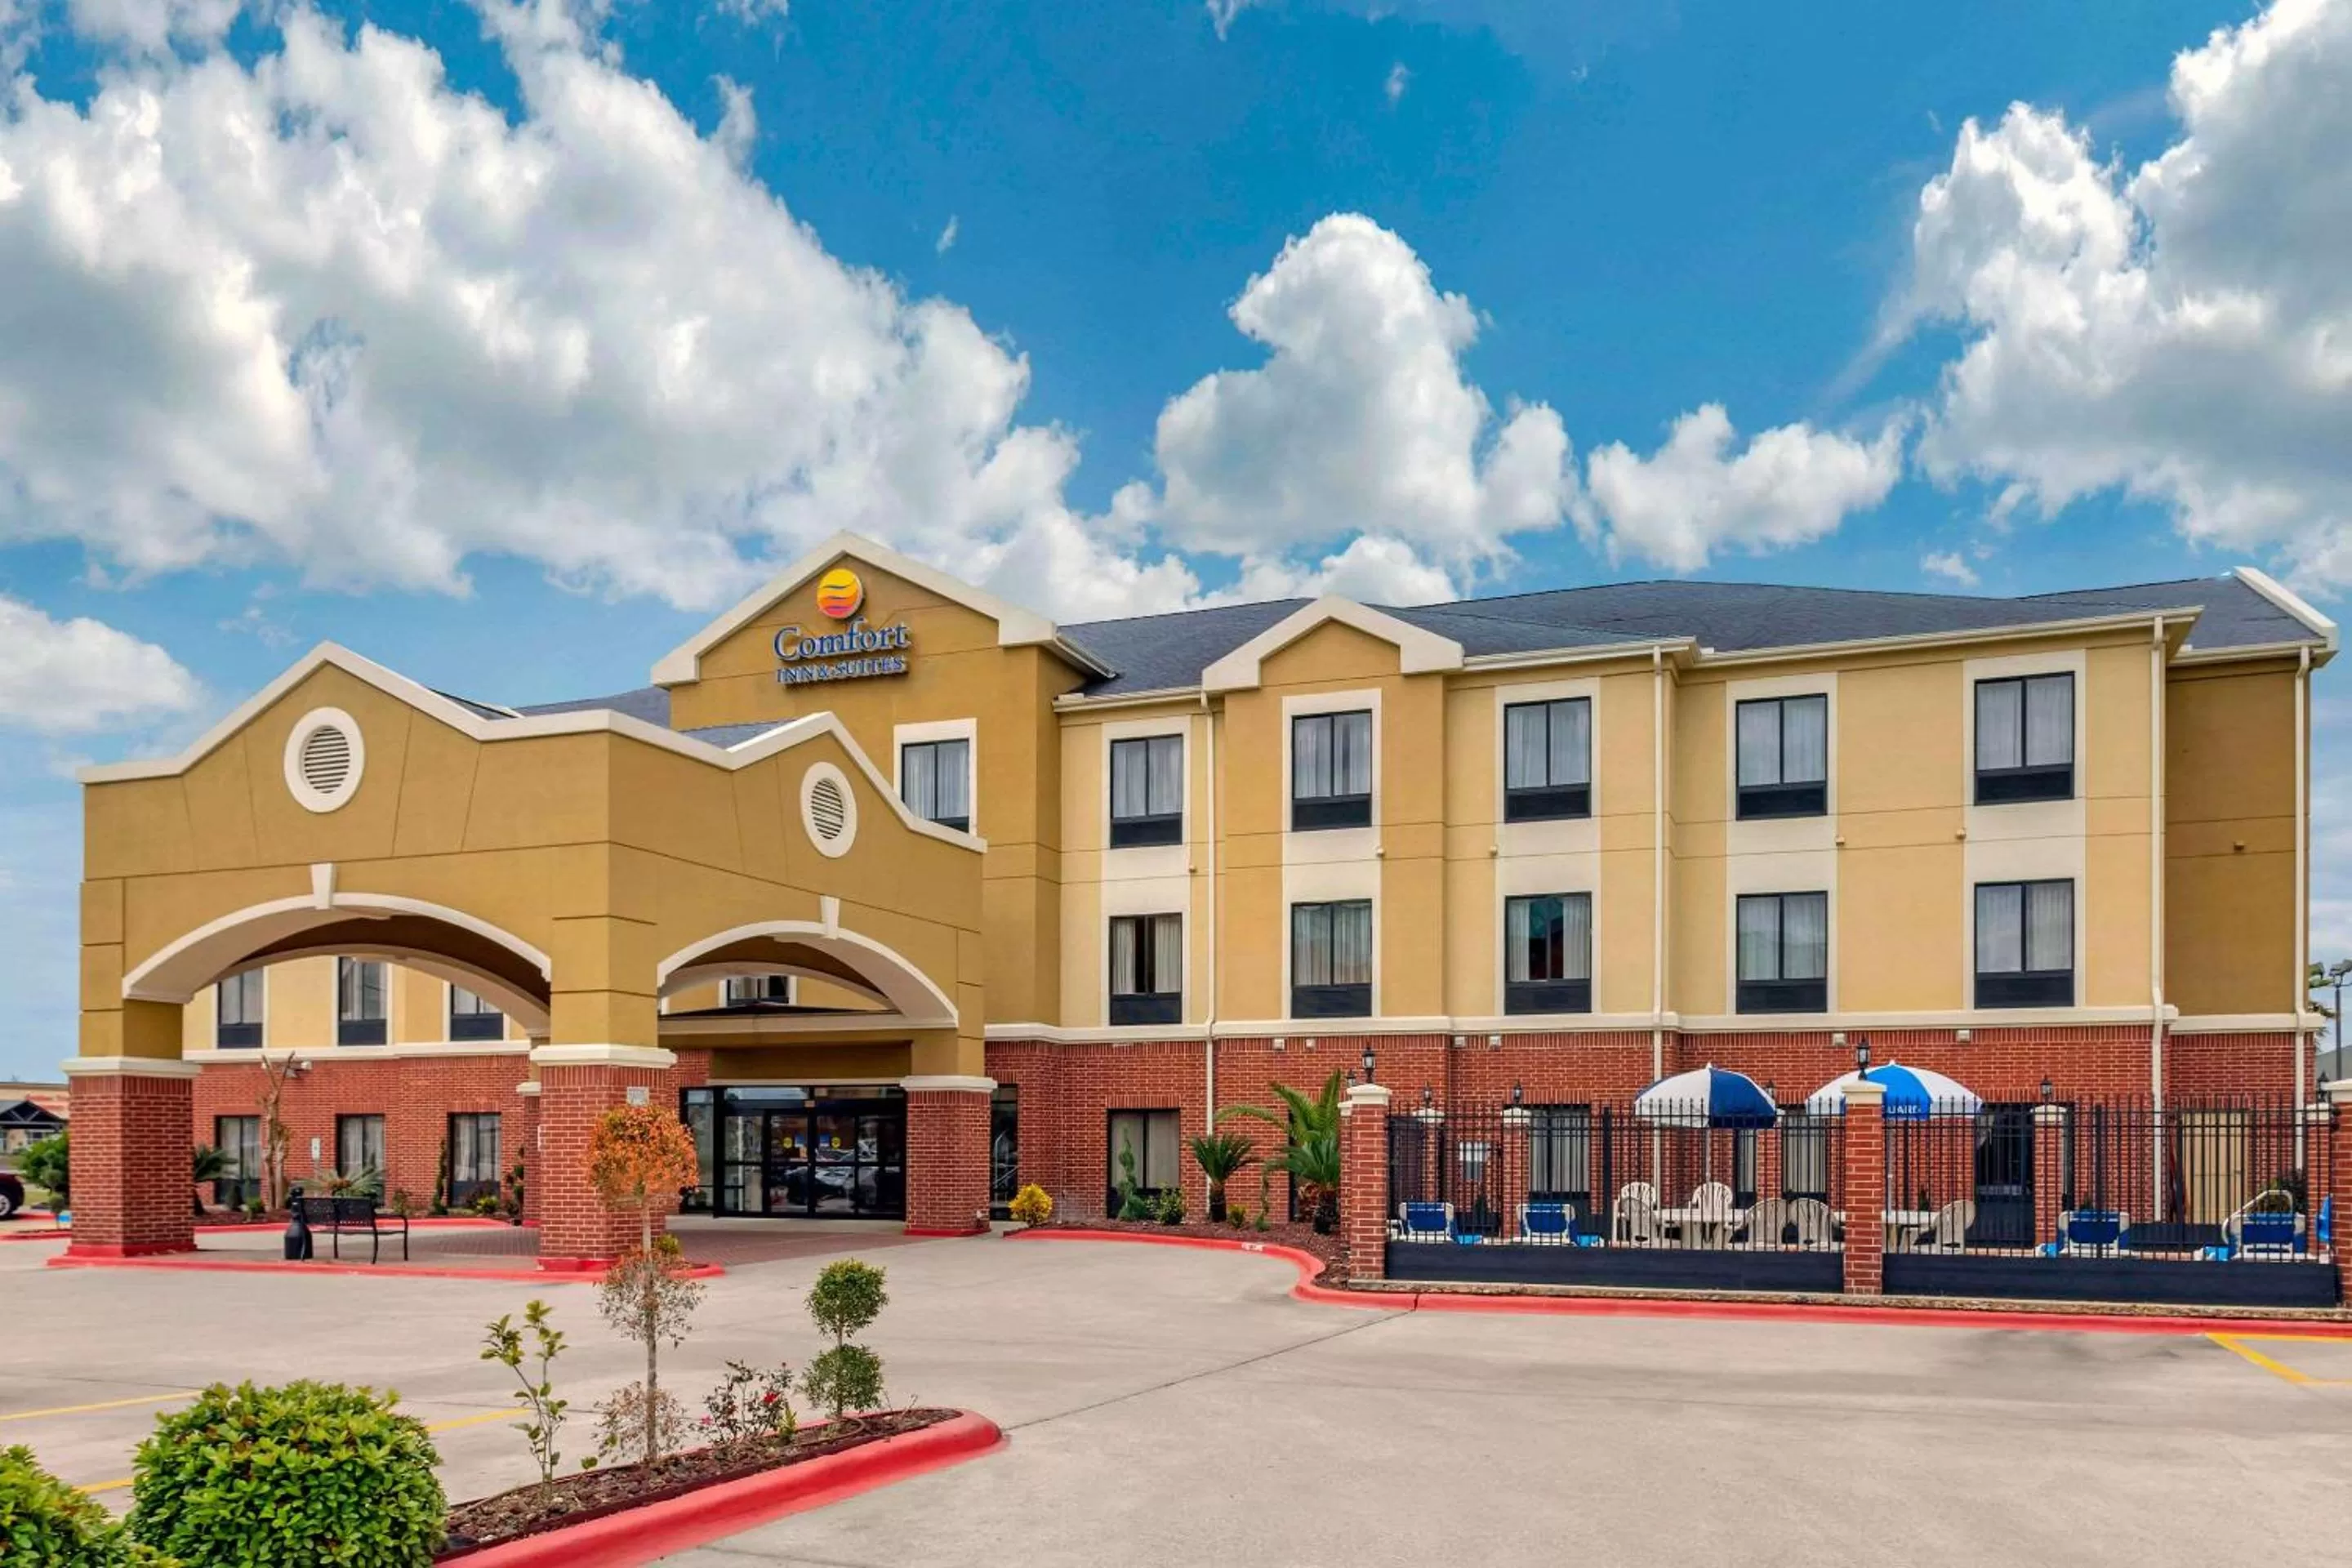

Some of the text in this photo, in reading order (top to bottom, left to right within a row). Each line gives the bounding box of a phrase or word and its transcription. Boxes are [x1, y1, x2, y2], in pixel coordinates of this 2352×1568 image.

[773, 617, 911, 660] Comfort
[777, 665, 816, 683] INN
[834, 656, 906, 677] SUITES
